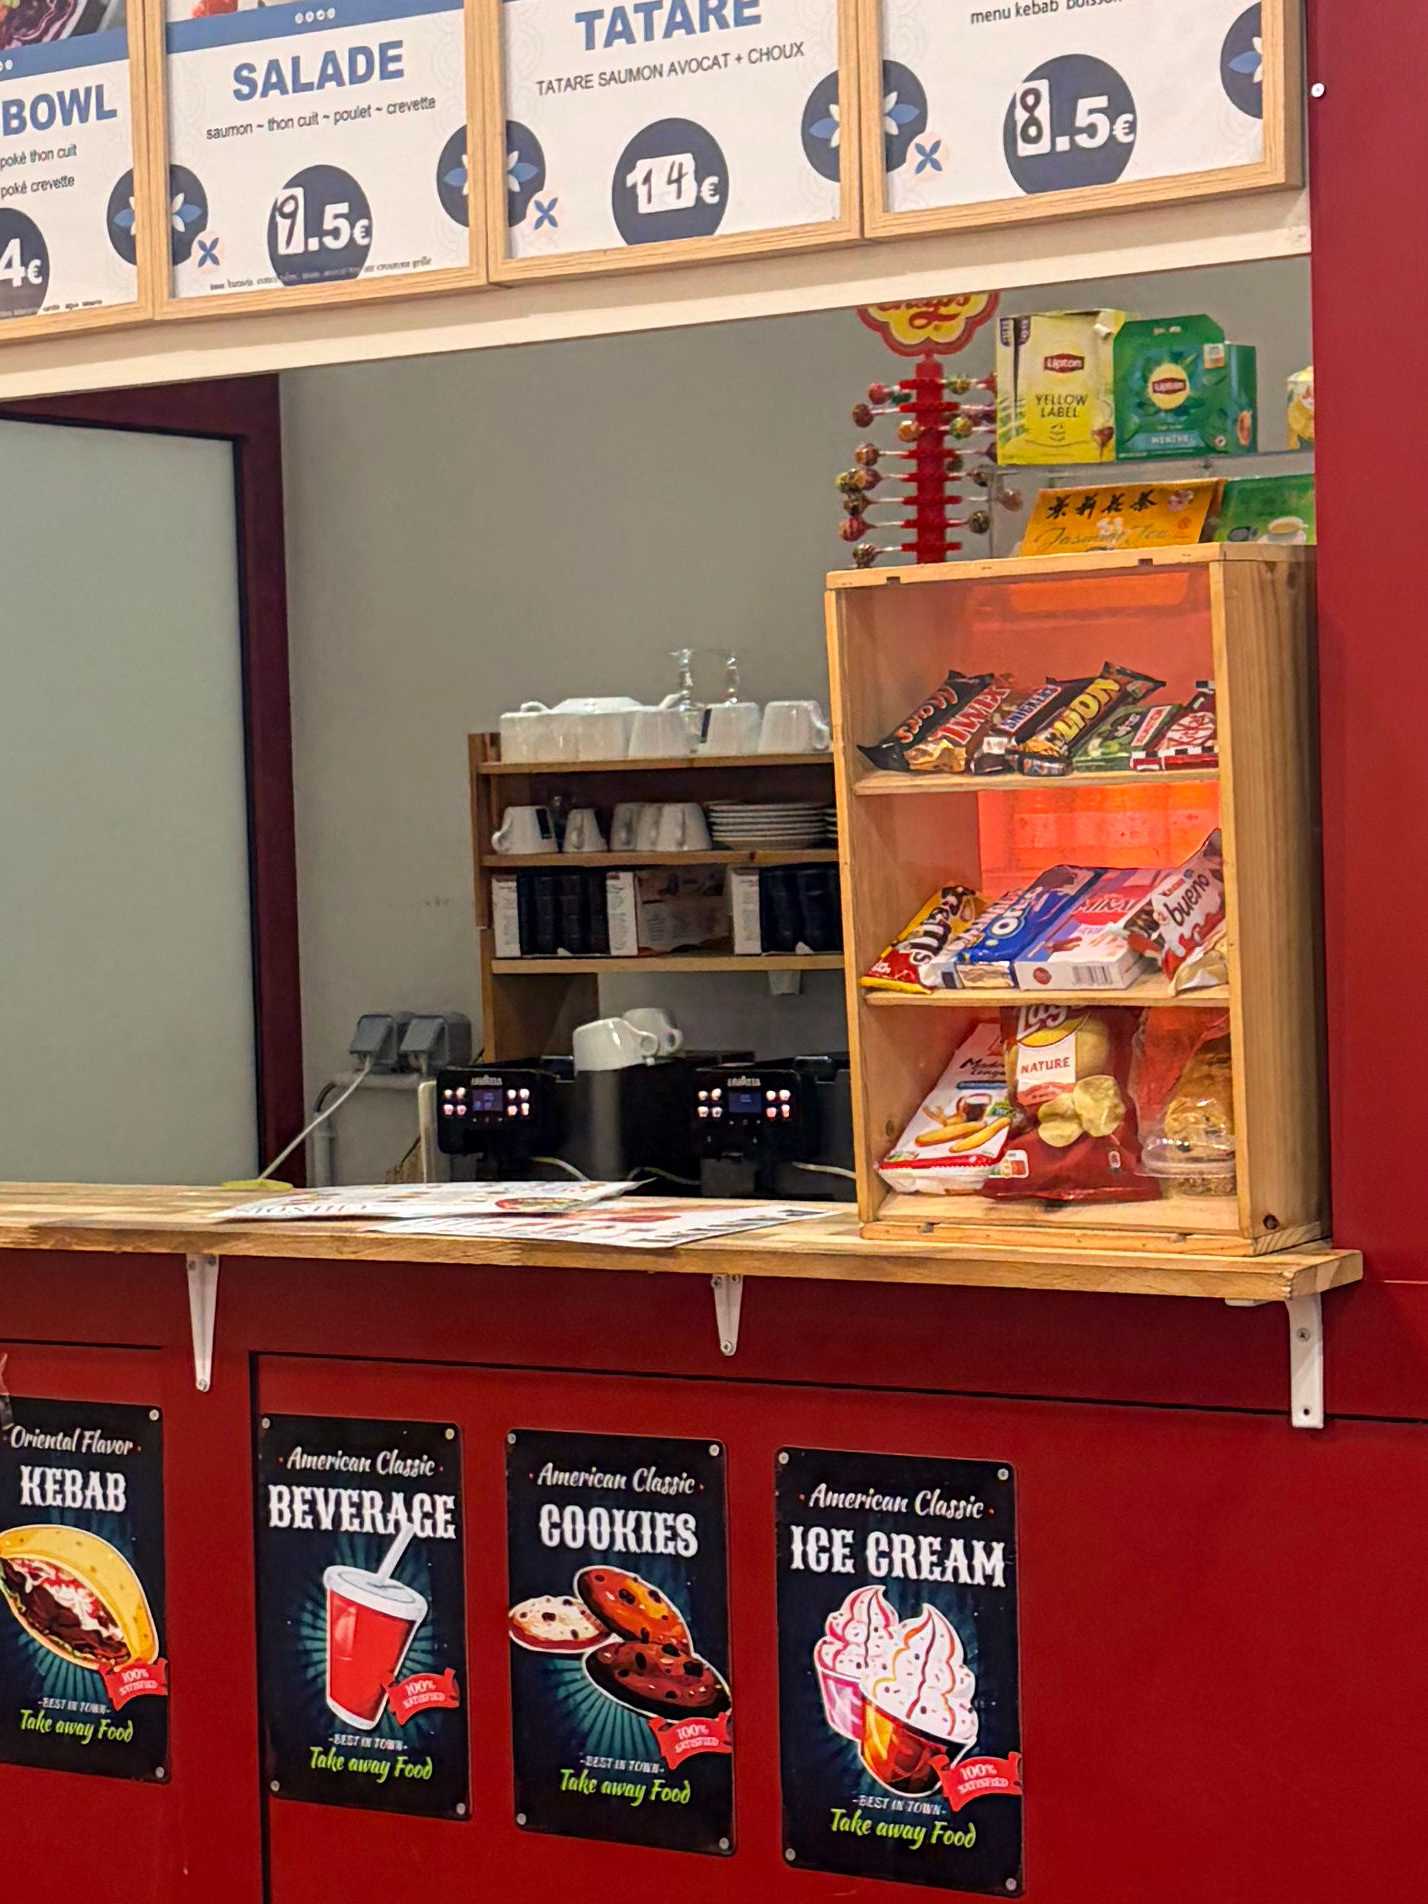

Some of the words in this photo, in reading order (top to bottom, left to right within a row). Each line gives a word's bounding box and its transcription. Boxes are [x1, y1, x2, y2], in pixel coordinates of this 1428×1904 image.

[970, 6, 1011, 24] menu
[232, 40, 404, 101] SALADE
[536, 74, 594, 96] TATARE
[598, 64, 663, 87] SAUMON
[667, 53, 730, 76] AVOCAT
[747, 42, 805, 64] CHOUX
[2, 84, 118, 136] BOWL
[206, 123, 253, 140] saumon
[268, 117, 294, 132] thon
[298, 112, 319, 128] cuit
[333, 106, 371, 125] poulet
[386, 96, 436, 115] crevette
[0, 152, 26, 169] poké
[29, 148, 54, 162] thon
[0, 181, 27, 199] poké
[30, 175, 75, 193] crevette
[1046, 356, 1083, 370] Lipton
[1035, 394, 1089, 407] YELLOW
[1040, 406, 1080, 419] LABEL
[1052, 678, 1121, 741] LION
[1167, 871, 1210, 928] bueno
[1021, 1056, 1071, 1075] NATURE
[10, 1425, 79, 1453] Oriental
[81, 1429, 134, 1456] Flavor
[286, 1446, 372, 1473] American
[375, 1448, 436, 1478] Classic
[537, 1462, 628, 1490] American
[632, 1466, 696, 1495] Classic
[19, 1465, 127, 1512] KEBAB
[809, 1483, 908, 1514] American
[914, 1489, 985, 1521] Classic
[268, 1484, 456, 1540] BEVERAGE
[539, 1503, 698, 1558] COOKIES
[790, 1525, 856, 1575] ICE
[866, 1530, 1007, 1588] CREAM
[20, 1709, 52, 1733] Take
[97, 1718, 134, 1743] Food
[309, 1746, 345, 1772] Take
[349, 1755, 392, 1783] away
[393, 1755, 433, 1781] Food
[560, 1768, 598, 1795] Take
[601, 1778, 647, 1807] away
[650, 1777, 691, 1805] Food
[830, 1807, 873, 1836] Take
[876, 1817, 927, 1850] away
[930, 1818, 977, 1849] Food
